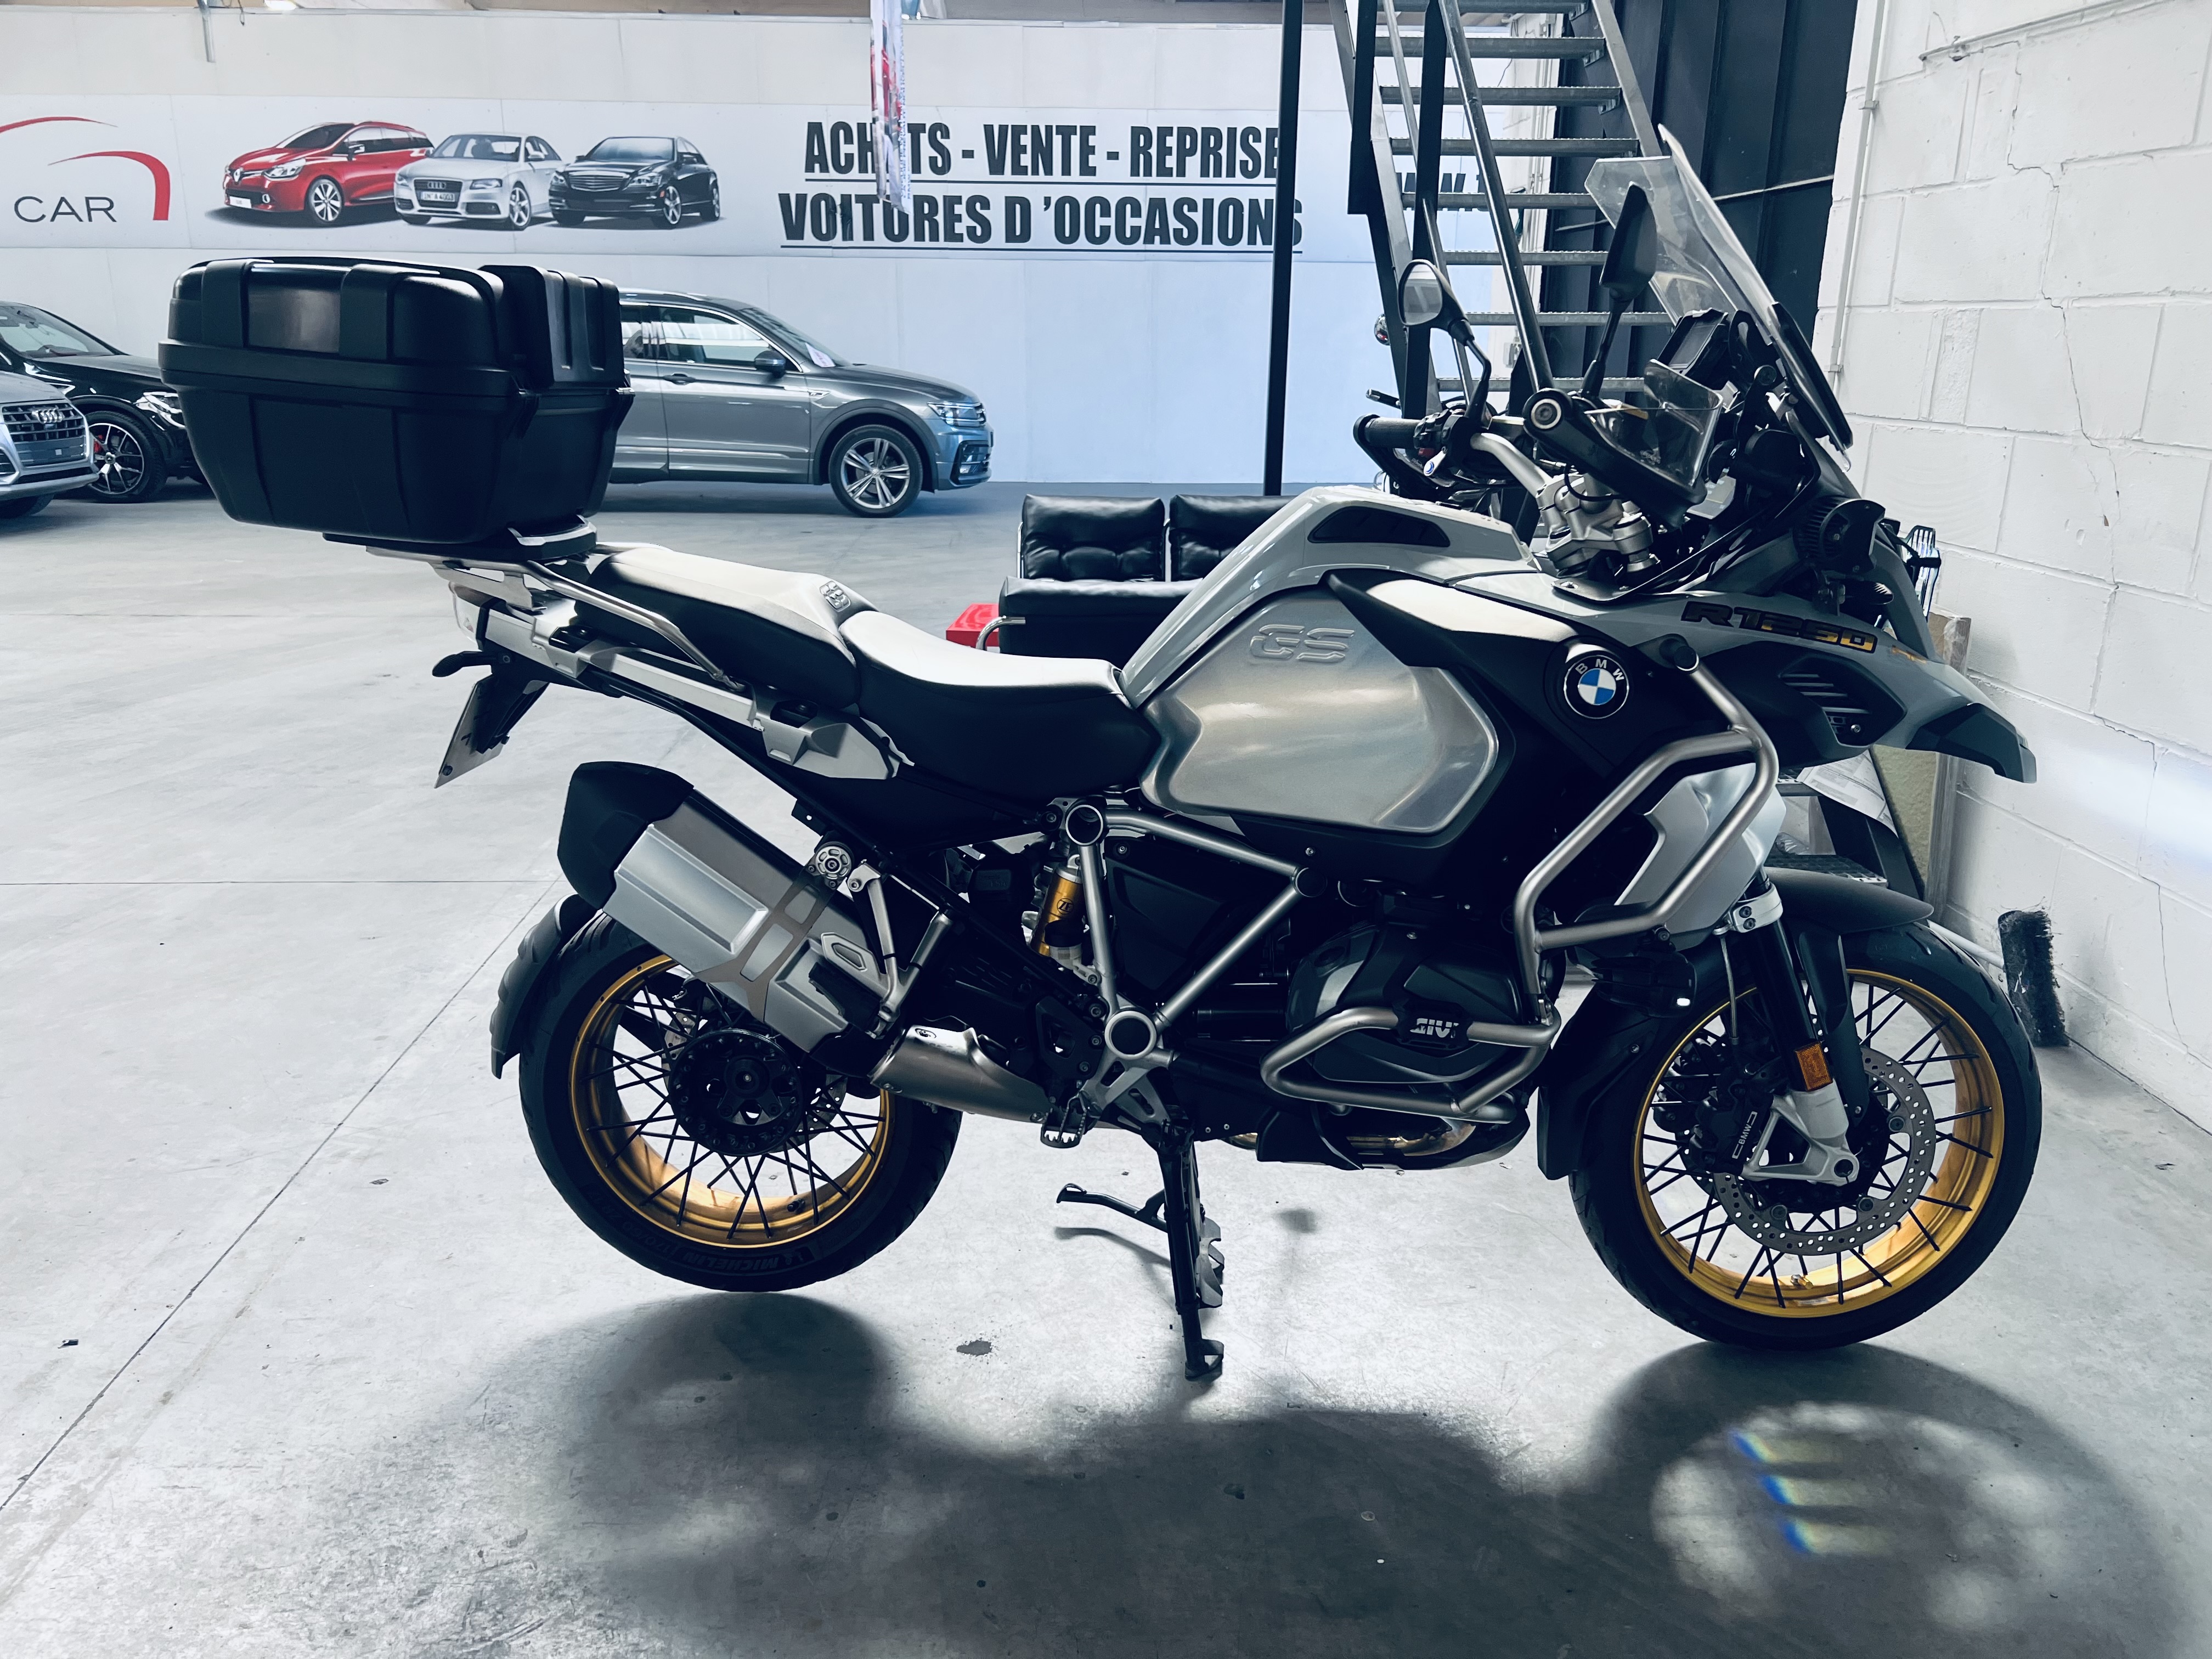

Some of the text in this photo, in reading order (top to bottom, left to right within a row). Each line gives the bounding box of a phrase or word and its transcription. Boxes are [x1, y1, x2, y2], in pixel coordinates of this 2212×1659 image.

[804, 121, 952, 176] ACHTS
[983, 124, 1097, 177] VENTE
[1130, 126, 1279, 179] REPRISE
[14, 196, 117, 223] CAR
[778, 193, 992, 244] VOITURES
[1250, 624, 1355, 665] GS
[1575, 658, 1625, 681] BMW
[1738, 1123, 1753, 1146] BMW
[681, 1251, 780, 1271] MICHELIN
